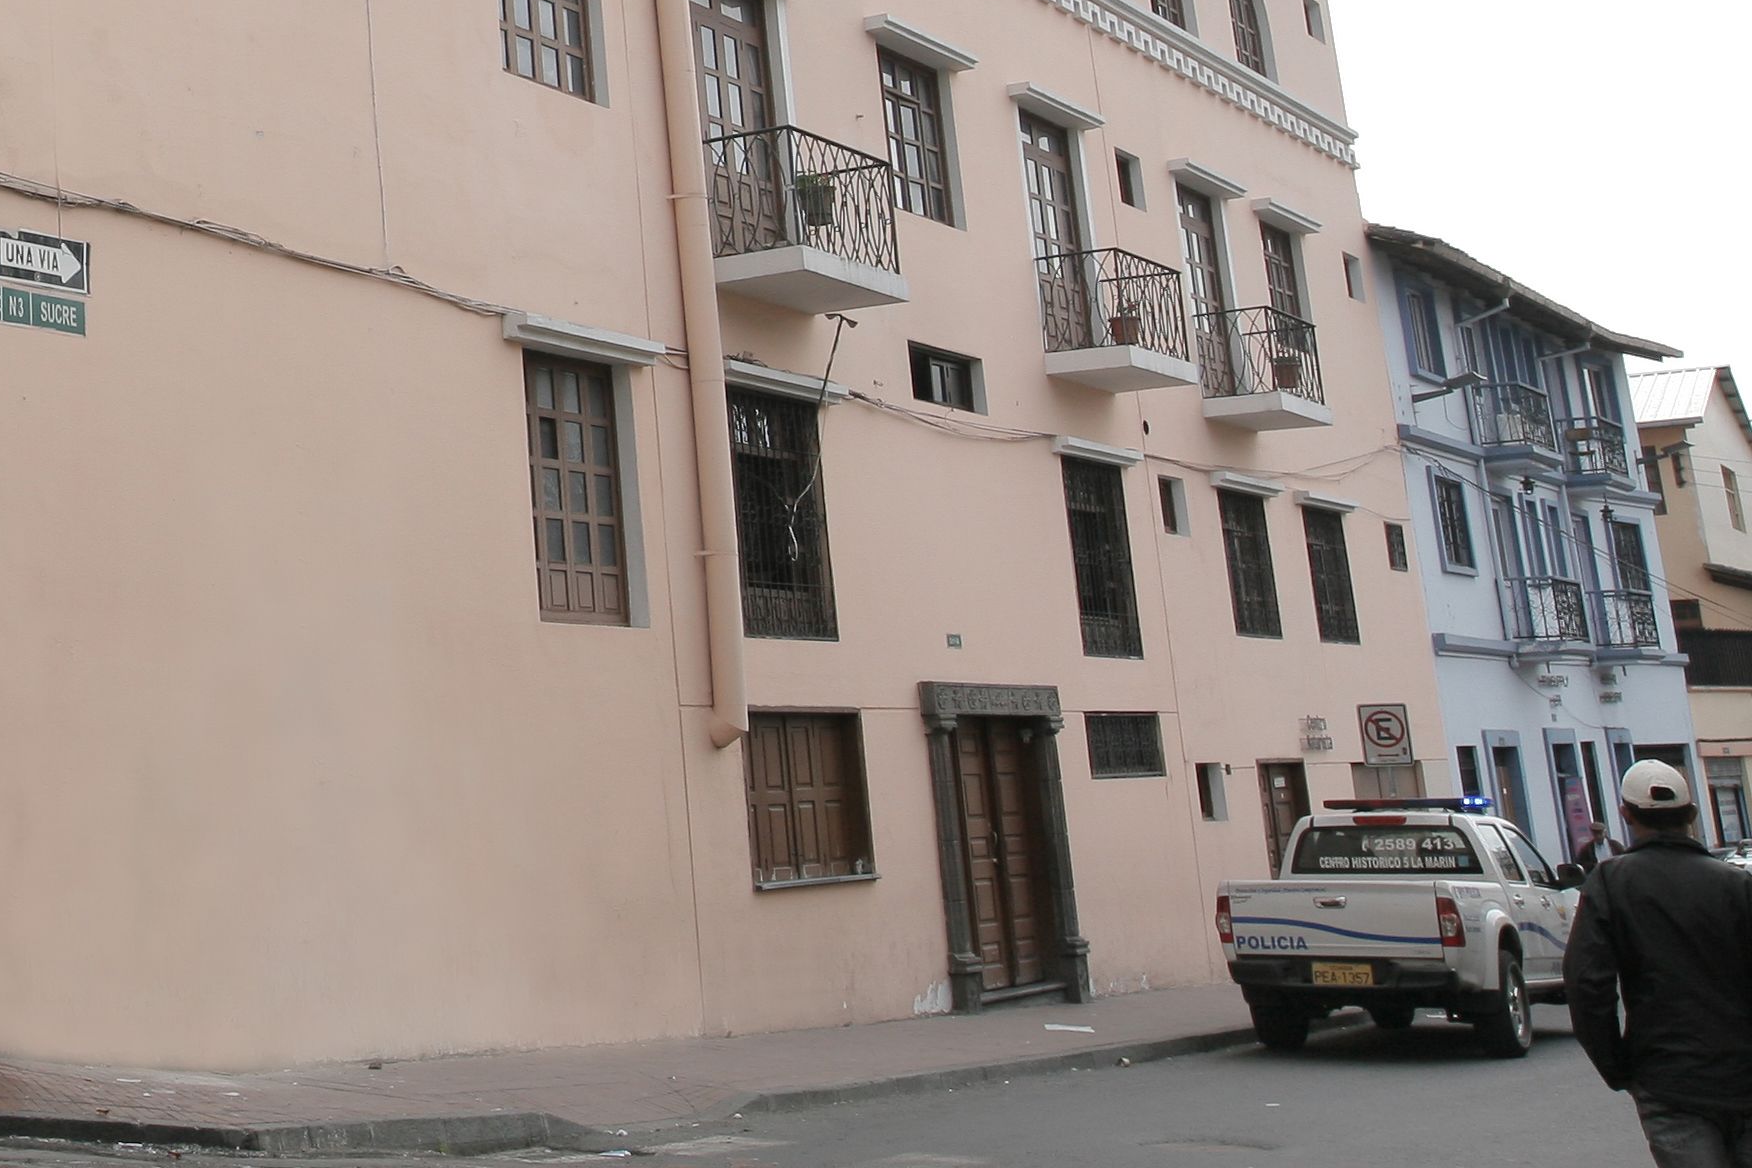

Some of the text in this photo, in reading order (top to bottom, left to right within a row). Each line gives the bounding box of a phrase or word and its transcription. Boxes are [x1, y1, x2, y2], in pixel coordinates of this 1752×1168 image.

[6, 243, 59, 271] UNA VIA
[9, 295, 77, 327] N3 SUCRE
[1374, 837, 1454, 851] 2589 413
[1319, 856, 1456, 869] CENTRO HISTORICO 5 LA MARIN
[1236, 935, 1308, 950] POLICIA
[1314, 970, 1370, 984] PEA-1357
